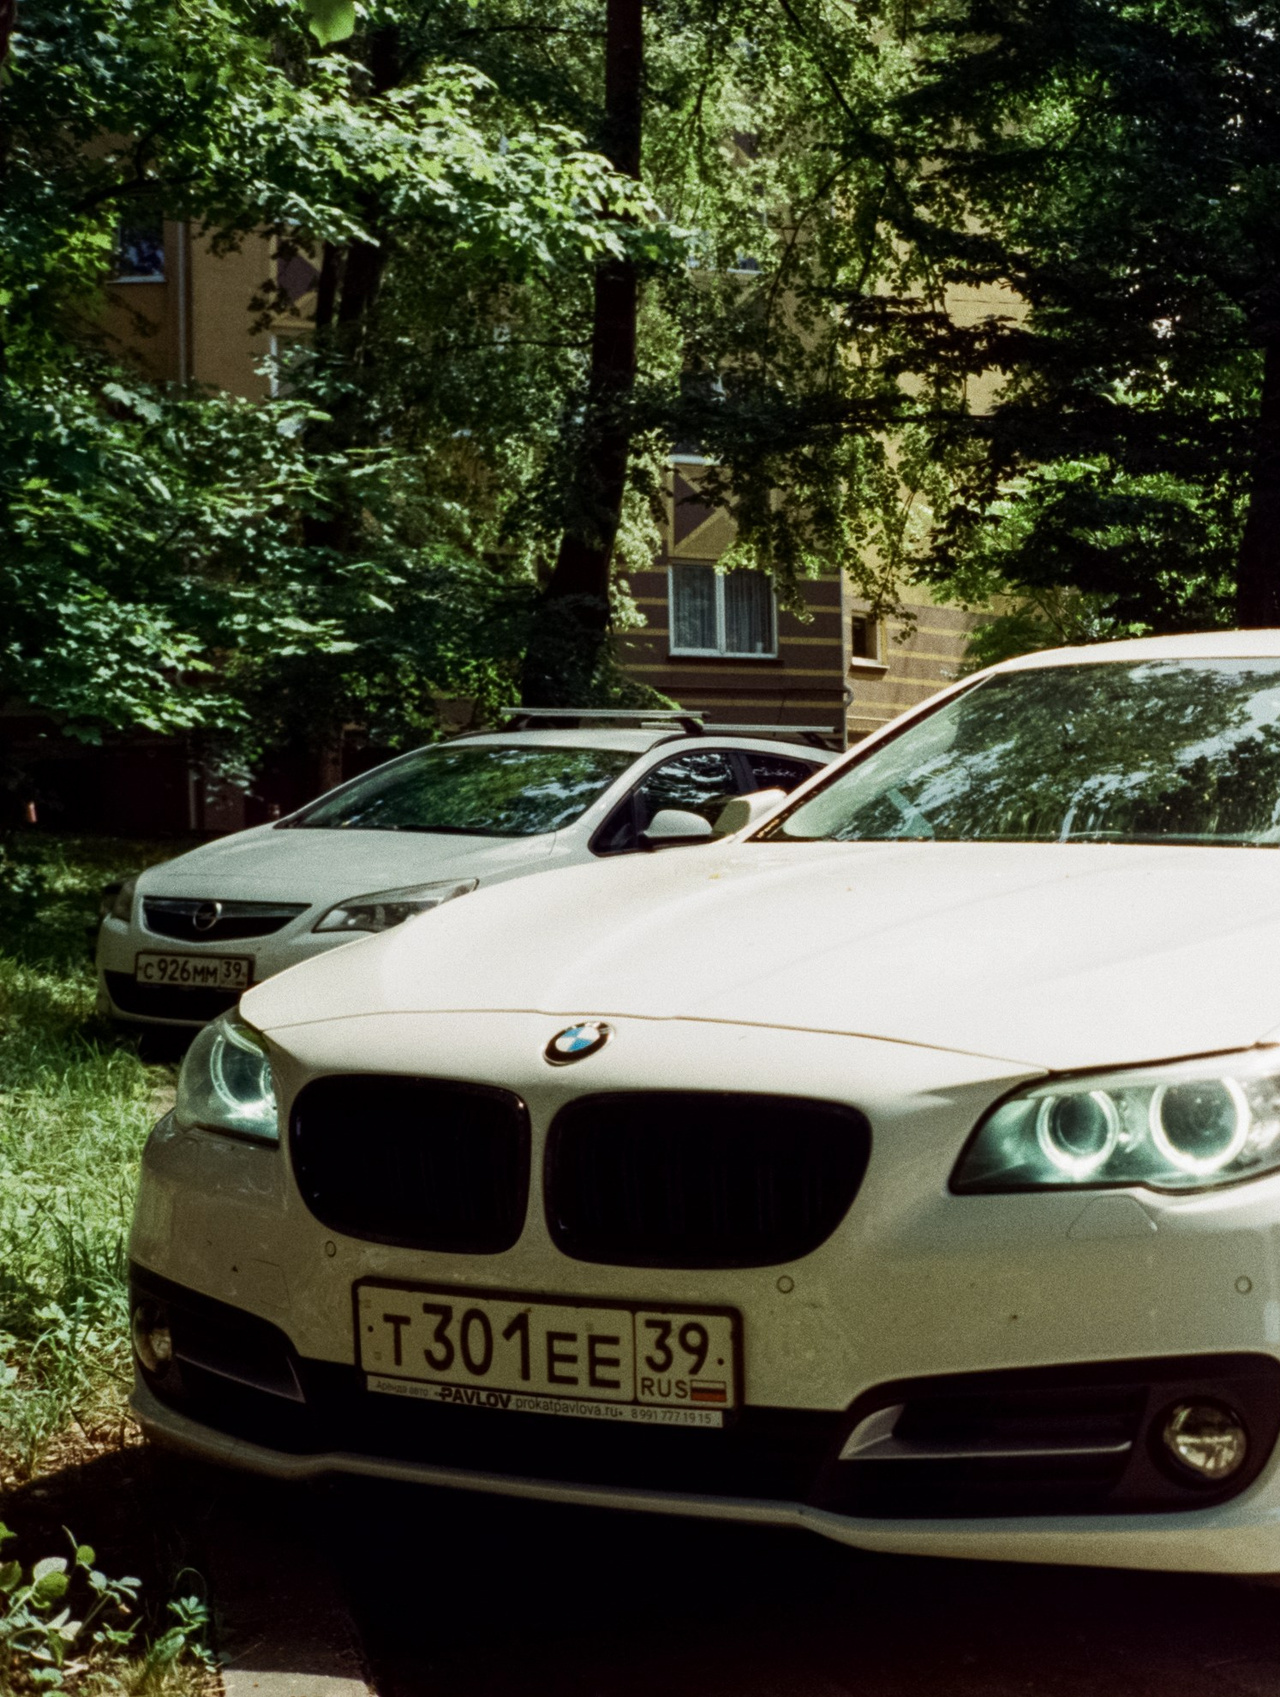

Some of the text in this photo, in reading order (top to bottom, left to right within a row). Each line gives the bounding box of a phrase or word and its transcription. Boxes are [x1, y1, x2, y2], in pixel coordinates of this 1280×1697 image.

[223, 961, 242, 979] 39
[383, 1302, 709, 1389] T301EE 39
[437, 1386, 511, 1409] PAVLOV
[641, 1377, 688, 1399] RUS
